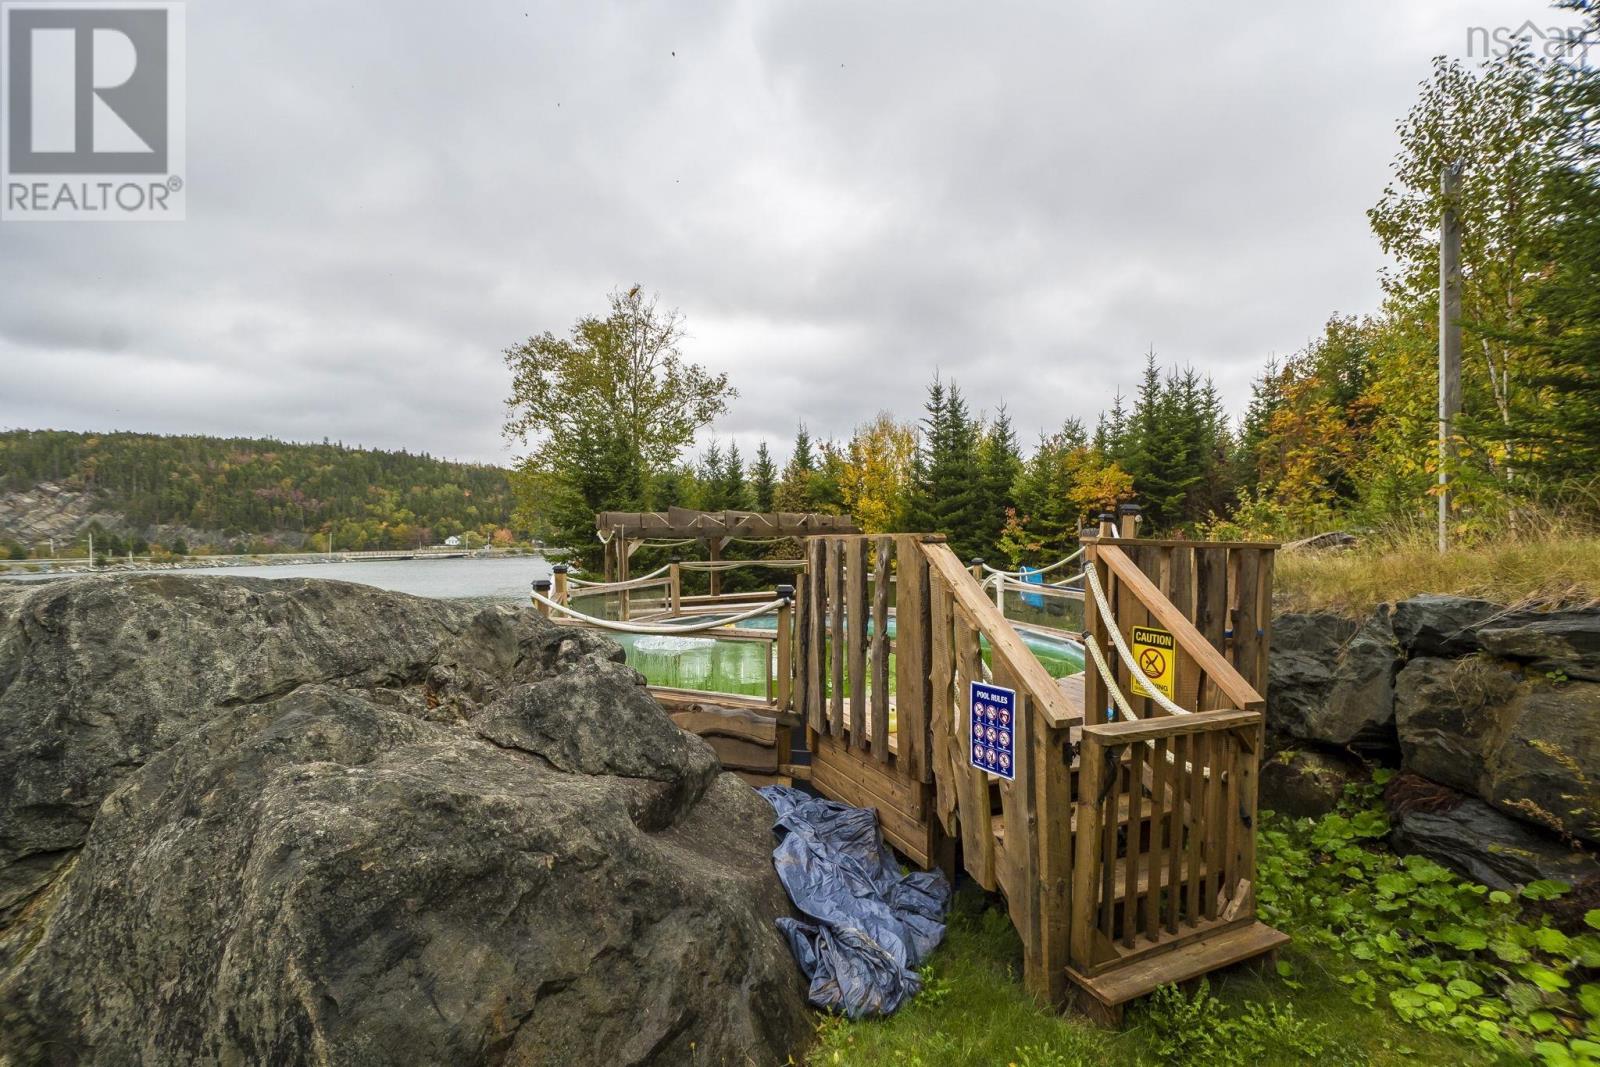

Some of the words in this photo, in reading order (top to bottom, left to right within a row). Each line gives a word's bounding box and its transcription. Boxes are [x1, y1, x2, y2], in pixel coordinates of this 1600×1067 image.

[1135, 631, 1172, 647] CAUTION
[976, 690, 990, 700] POOL
[990, 693, 1008, 704] RULES
